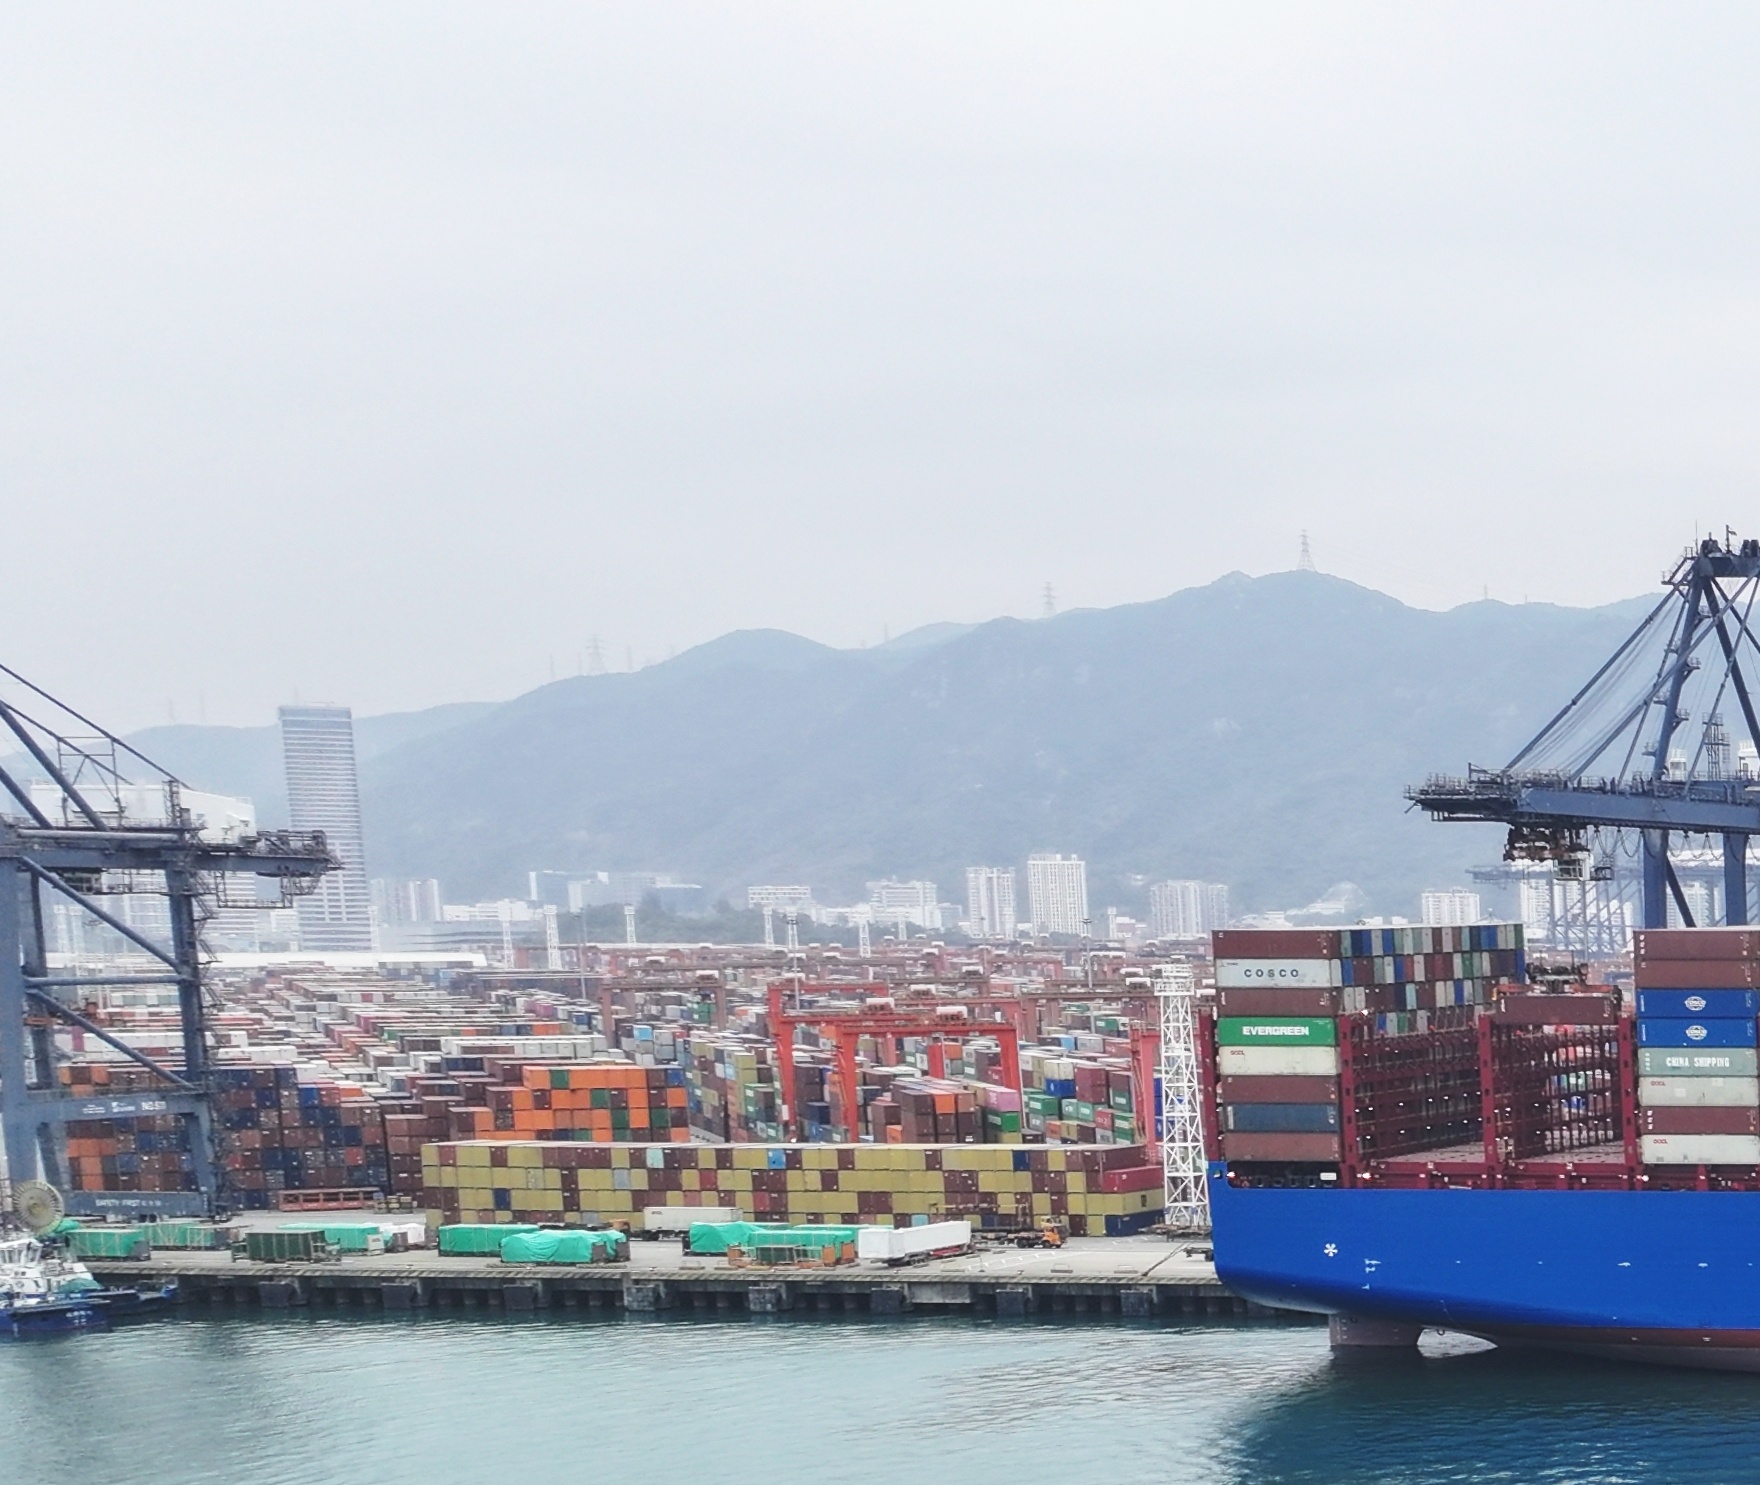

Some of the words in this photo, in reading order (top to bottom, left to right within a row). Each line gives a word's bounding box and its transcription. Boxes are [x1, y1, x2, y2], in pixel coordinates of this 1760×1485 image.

[1244, 969, 1299, 978] COSCO
[1242, 1026, 1309, 1036] EVERGREEN
[1665, 1057, 1690, 1067] CHINA
[1693, 1057, 1730, 1067] SHIPPING
